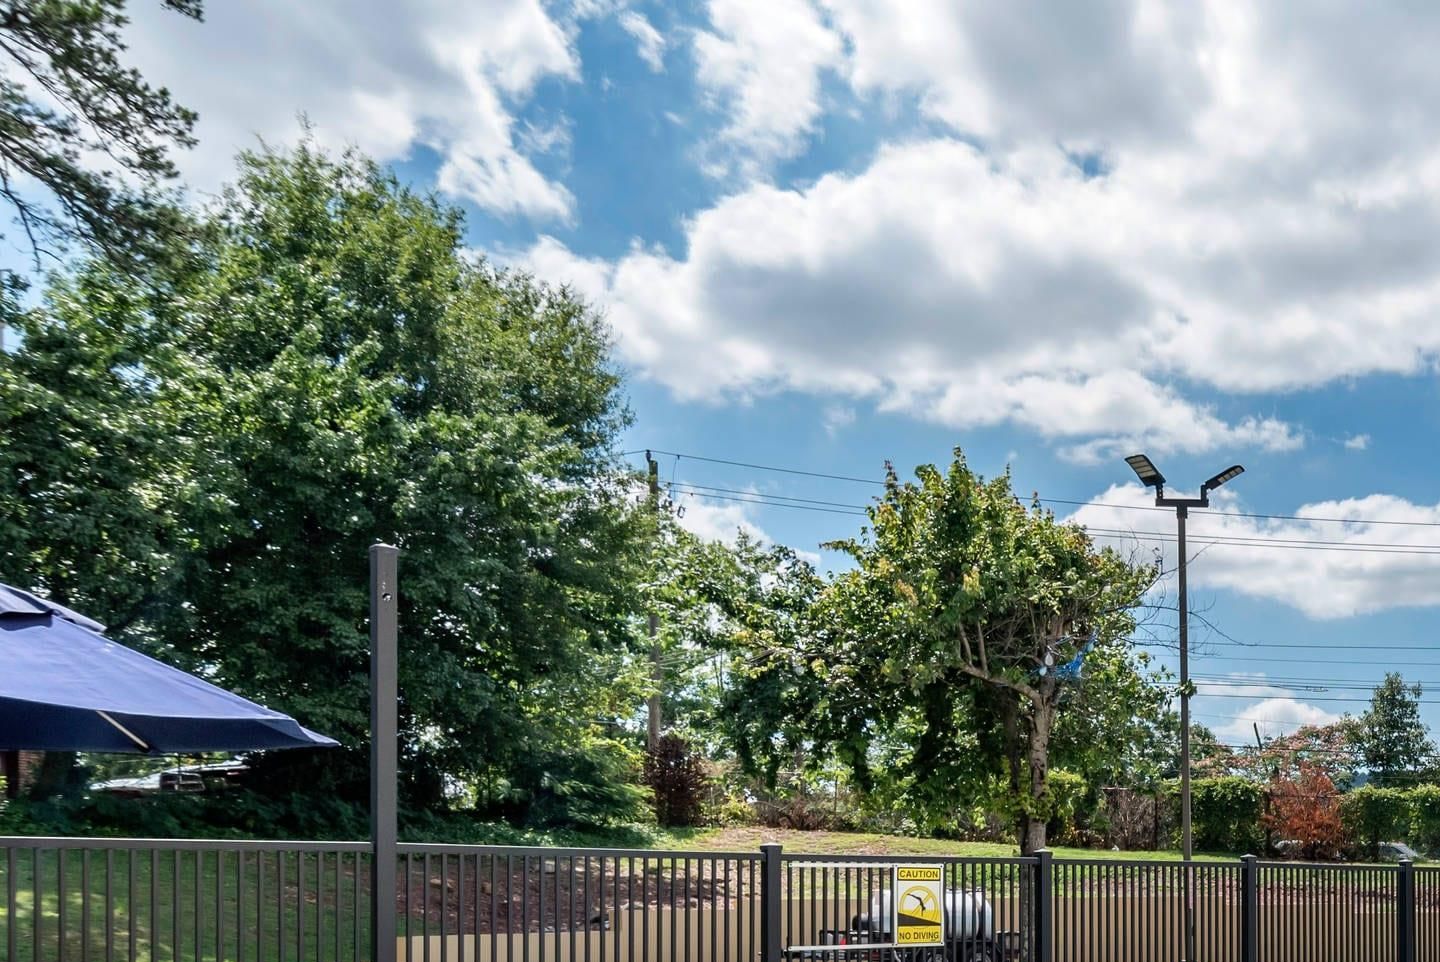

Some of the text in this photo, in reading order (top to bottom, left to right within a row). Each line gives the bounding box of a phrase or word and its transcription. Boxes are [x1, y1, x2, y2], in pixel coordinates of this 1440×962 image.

[899, 869, 938, 878] CAUTION
[899, 931, 939, 940] NO DIVING
